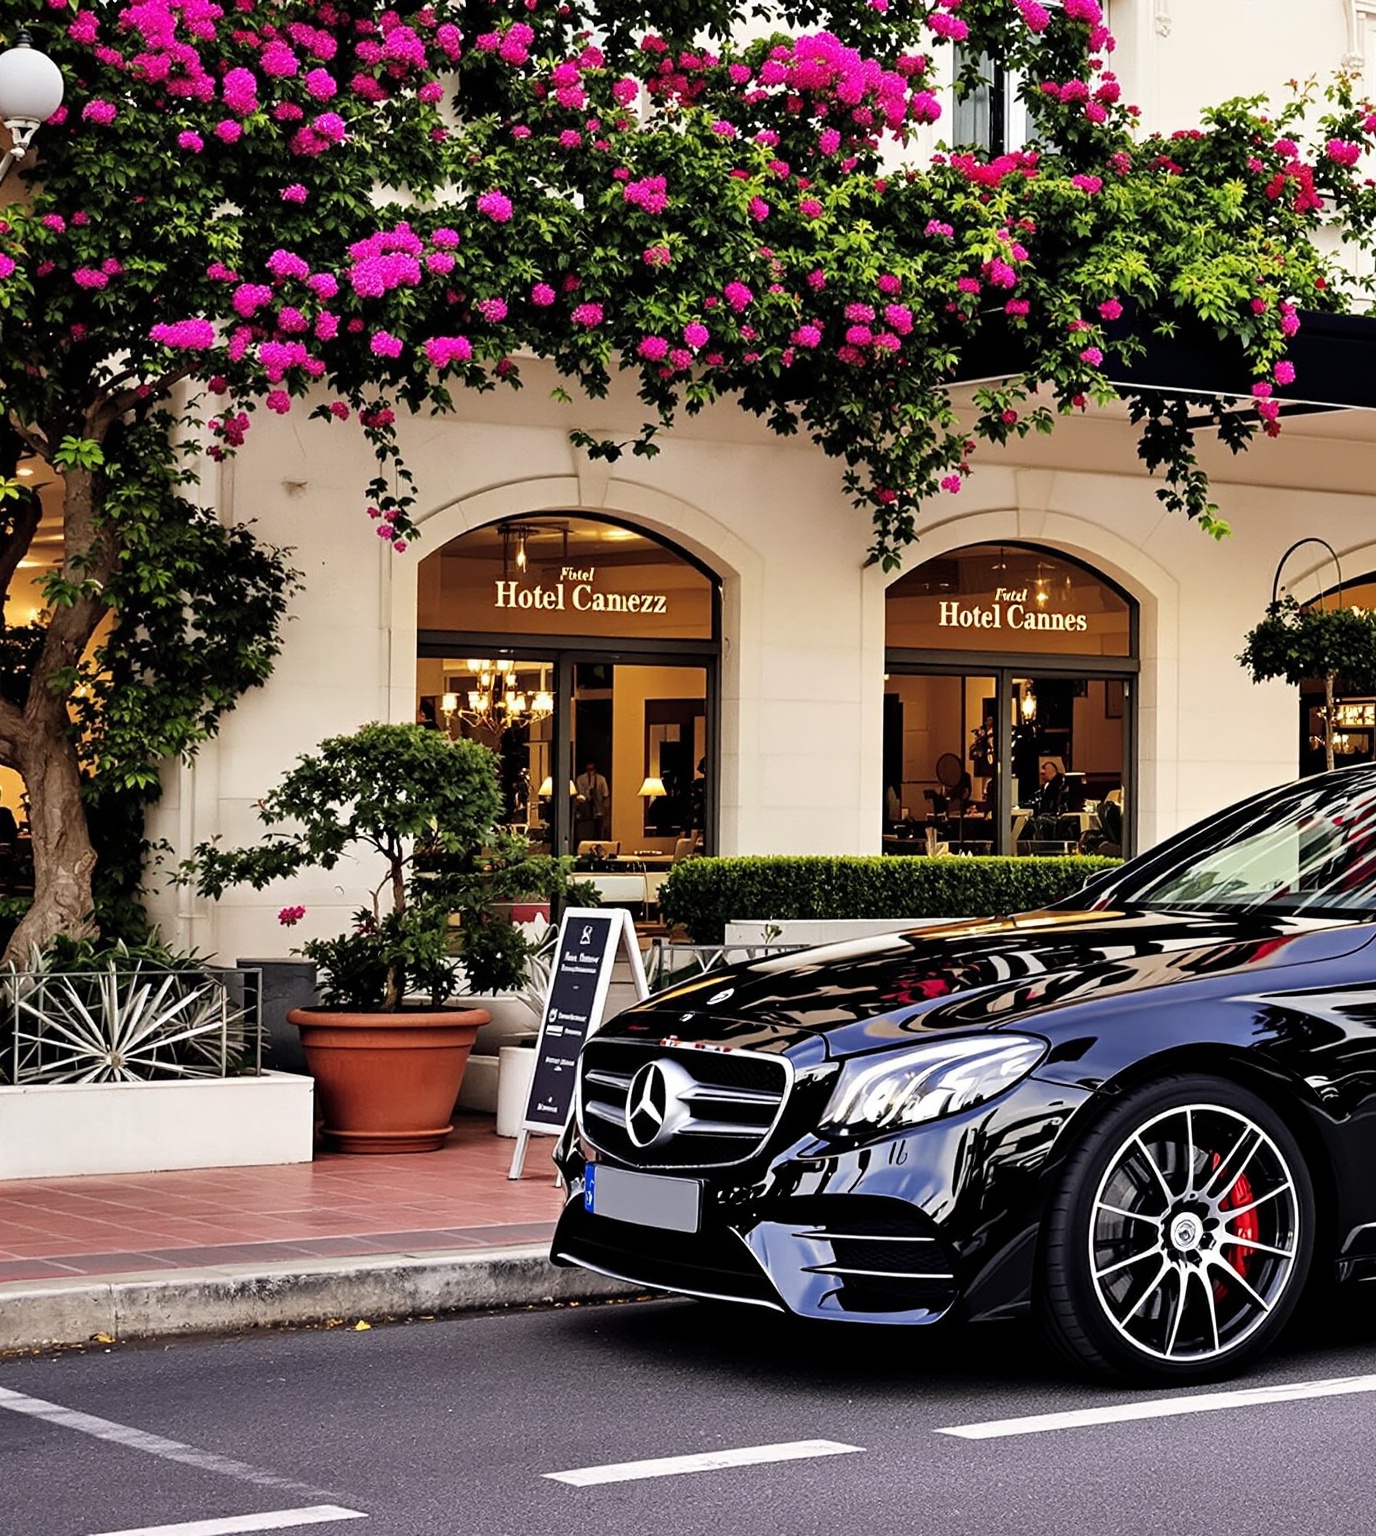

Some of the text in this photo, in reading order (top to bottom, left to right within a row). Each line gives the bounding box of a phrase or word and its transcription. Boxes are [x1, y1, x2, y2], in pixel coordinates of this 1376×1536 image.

[494, 580, 565, 610] Hotel
[938, 601, 1088, 631] Hotel Cannes
